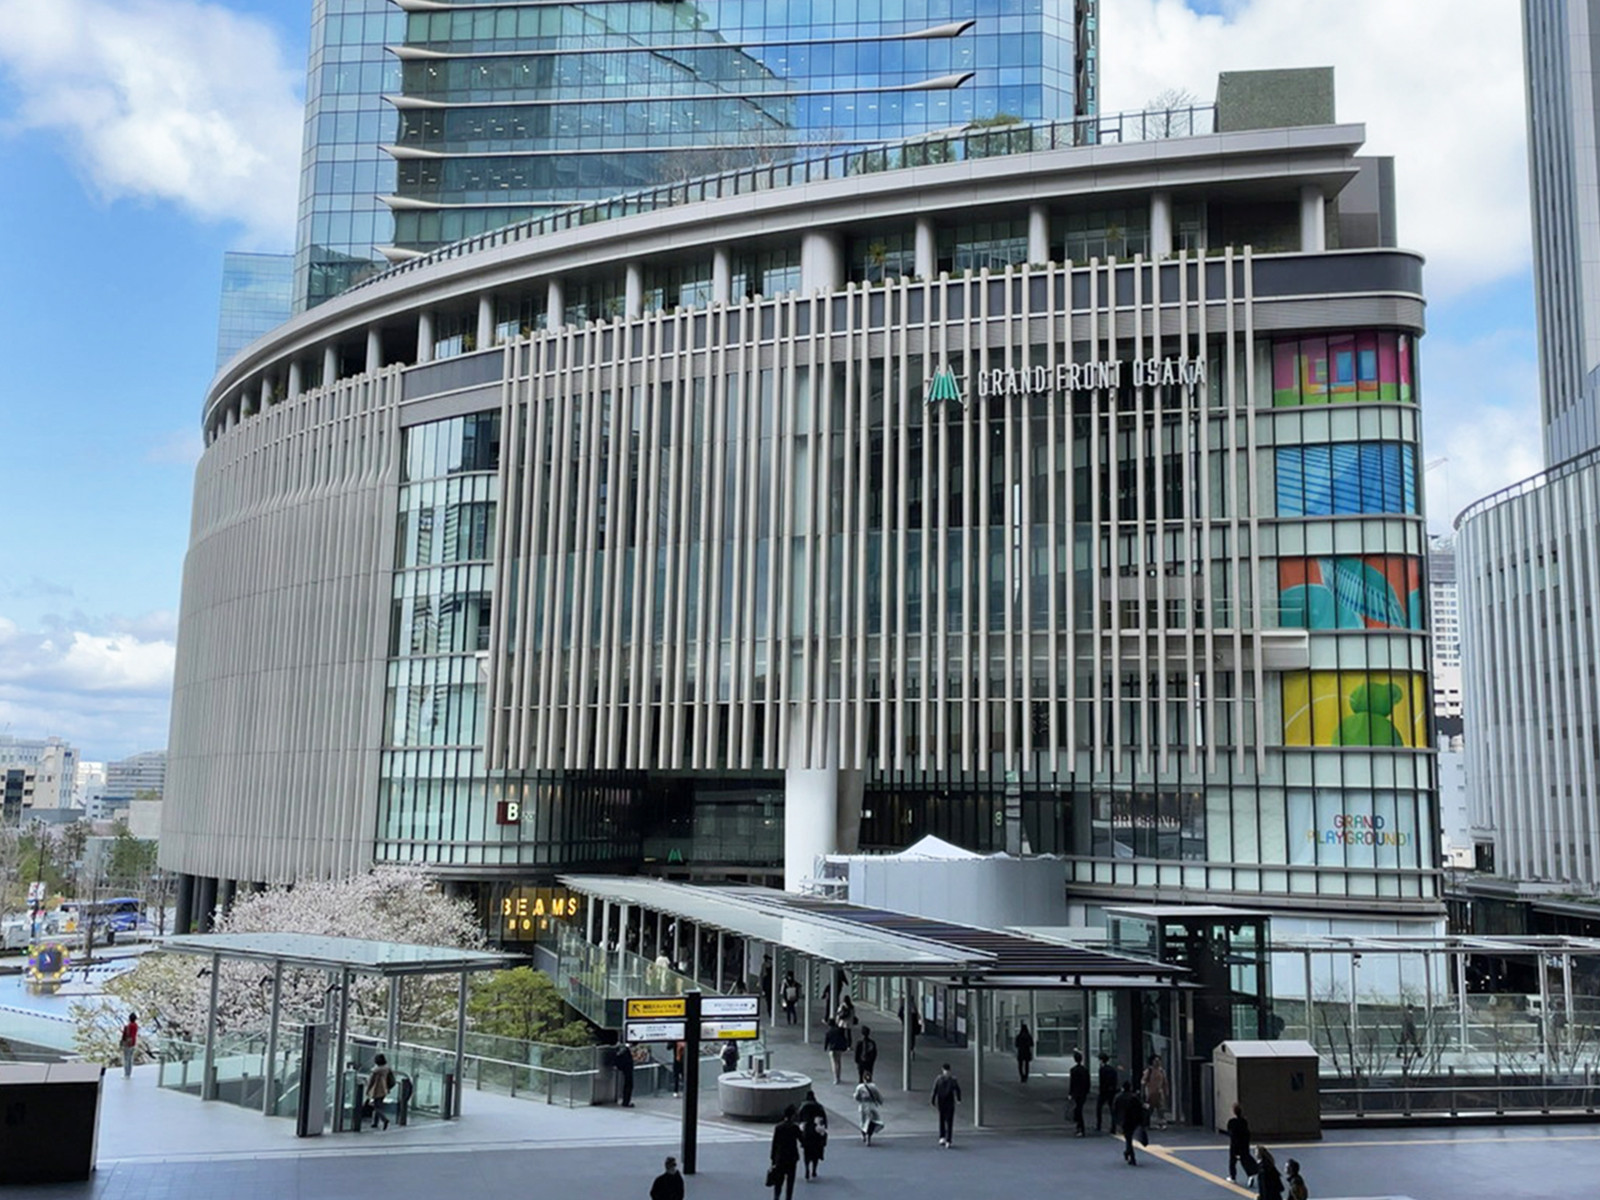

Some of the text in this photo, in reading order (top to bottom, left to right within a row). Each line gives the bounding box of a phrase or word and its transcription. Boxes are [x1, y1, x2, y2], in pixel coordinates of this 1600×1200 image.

[978, 354, 1206, 397] GRAND FRONT OSAKA
[507, 802, 519, 821] B
[1333, 814, 1385, 830] GRAND
[501, 897, 577, 916] BEAMS
